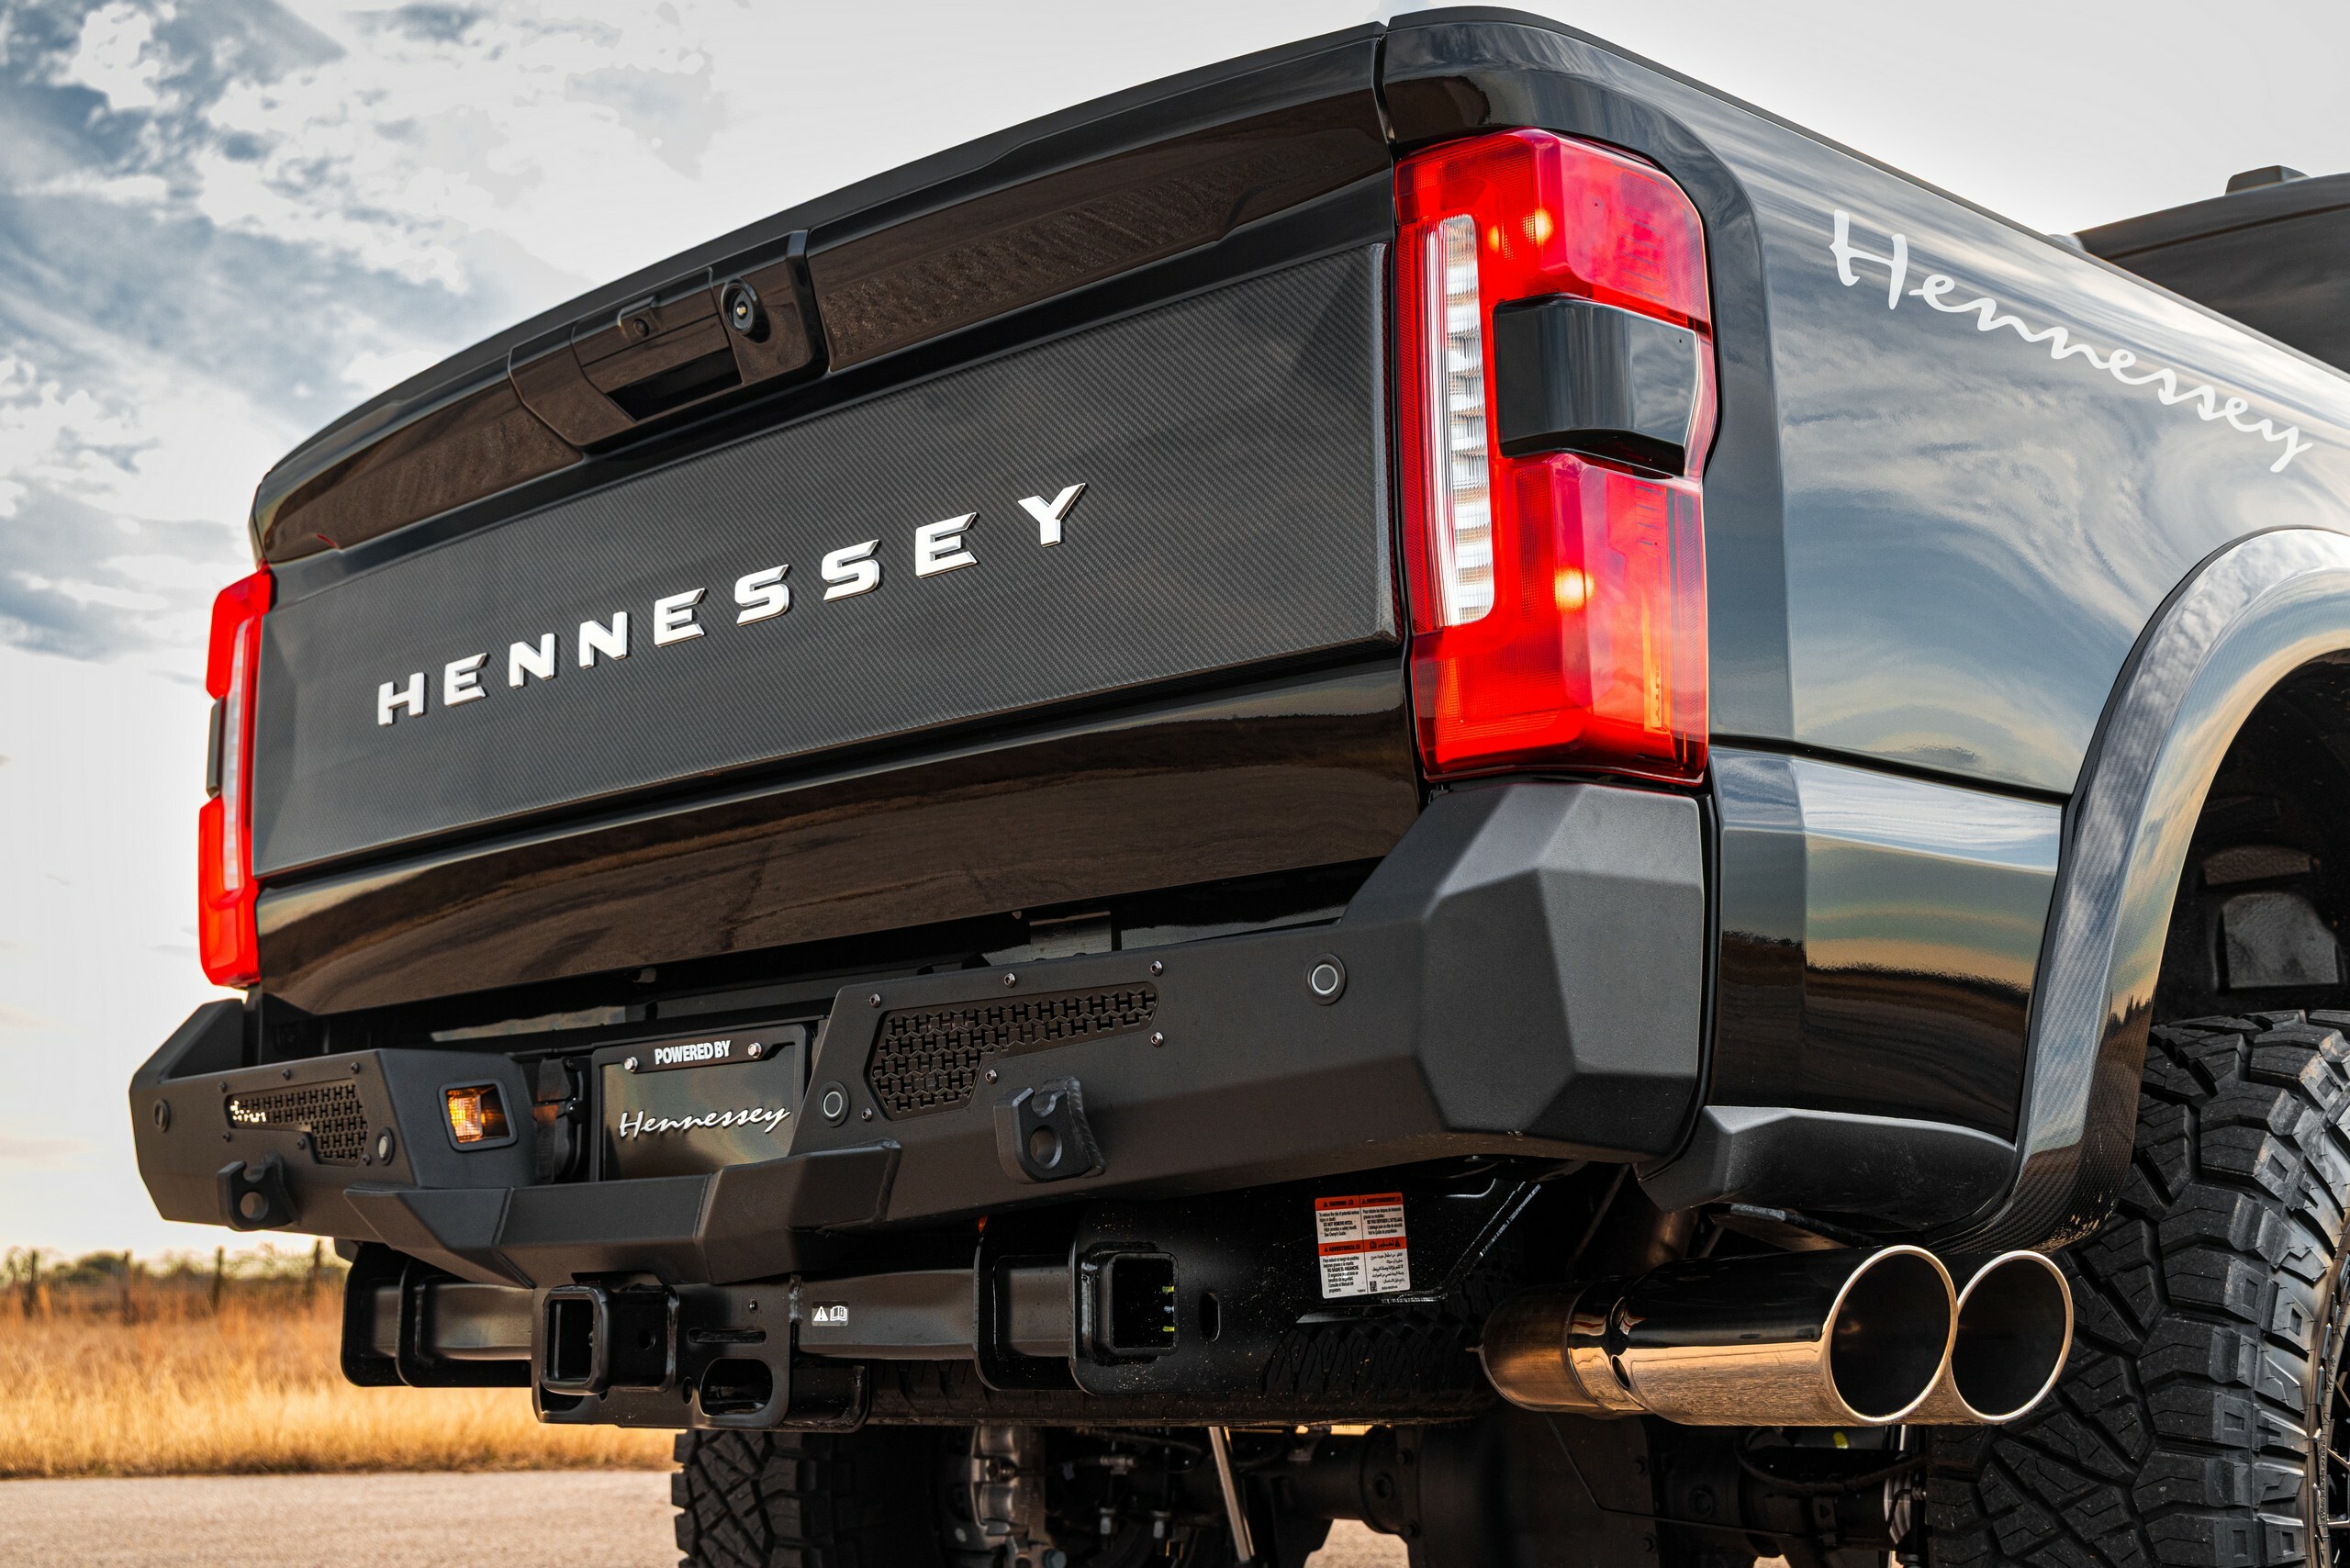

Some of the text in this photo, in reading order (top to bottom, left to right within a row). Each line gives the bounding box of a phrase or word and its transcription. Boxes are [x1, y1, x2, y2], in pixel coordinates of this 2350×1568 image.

[1829, 208, 2313, 474] Hennessey
[377, 482, 1087, 726] HENNESSEY
[655, 1040, 732, 1065] POWERED BY
[619, 1107, 791, 1137] Hennessey
